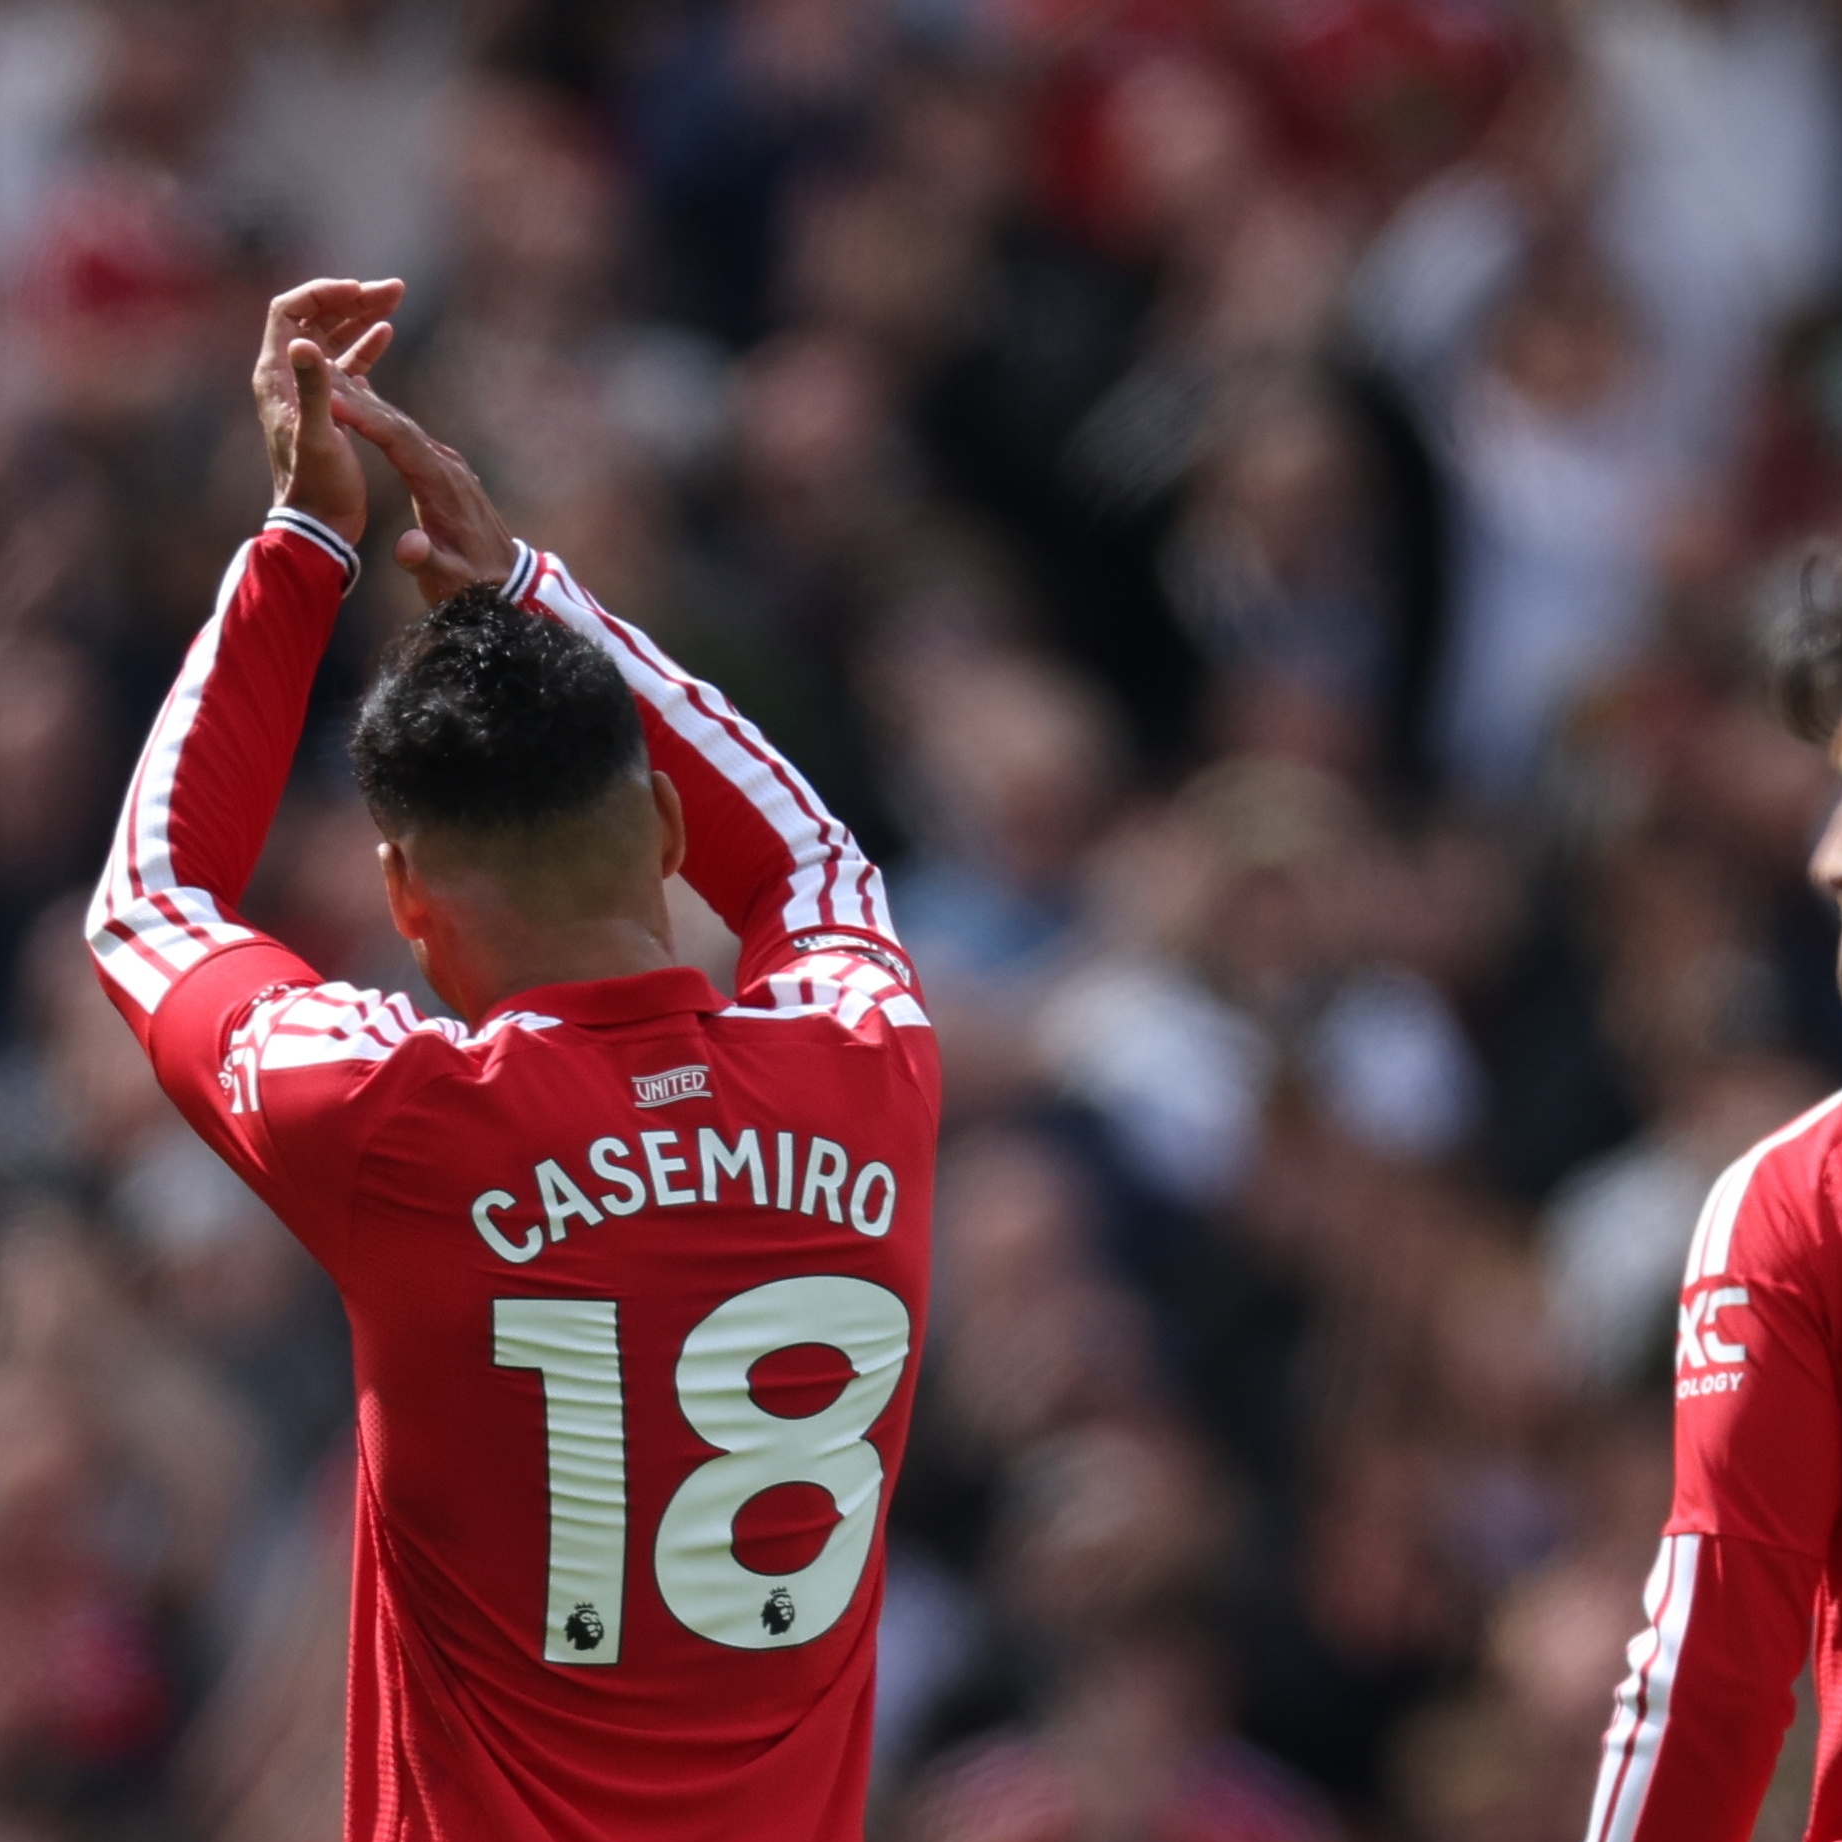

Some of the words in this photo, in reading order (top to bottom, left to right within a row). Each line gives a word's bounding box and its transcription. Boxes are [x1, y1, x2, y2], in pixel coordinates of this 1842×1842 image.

[636, 1071, 706, 1101] UNITED
[470, 1127, 897, 1264] CASEMIRO
[1676, 1286, 1750, 1376] XC
[1677, 1371, 1744, 1400] OLOGY
[492, 1273, 911, 1666] 18
